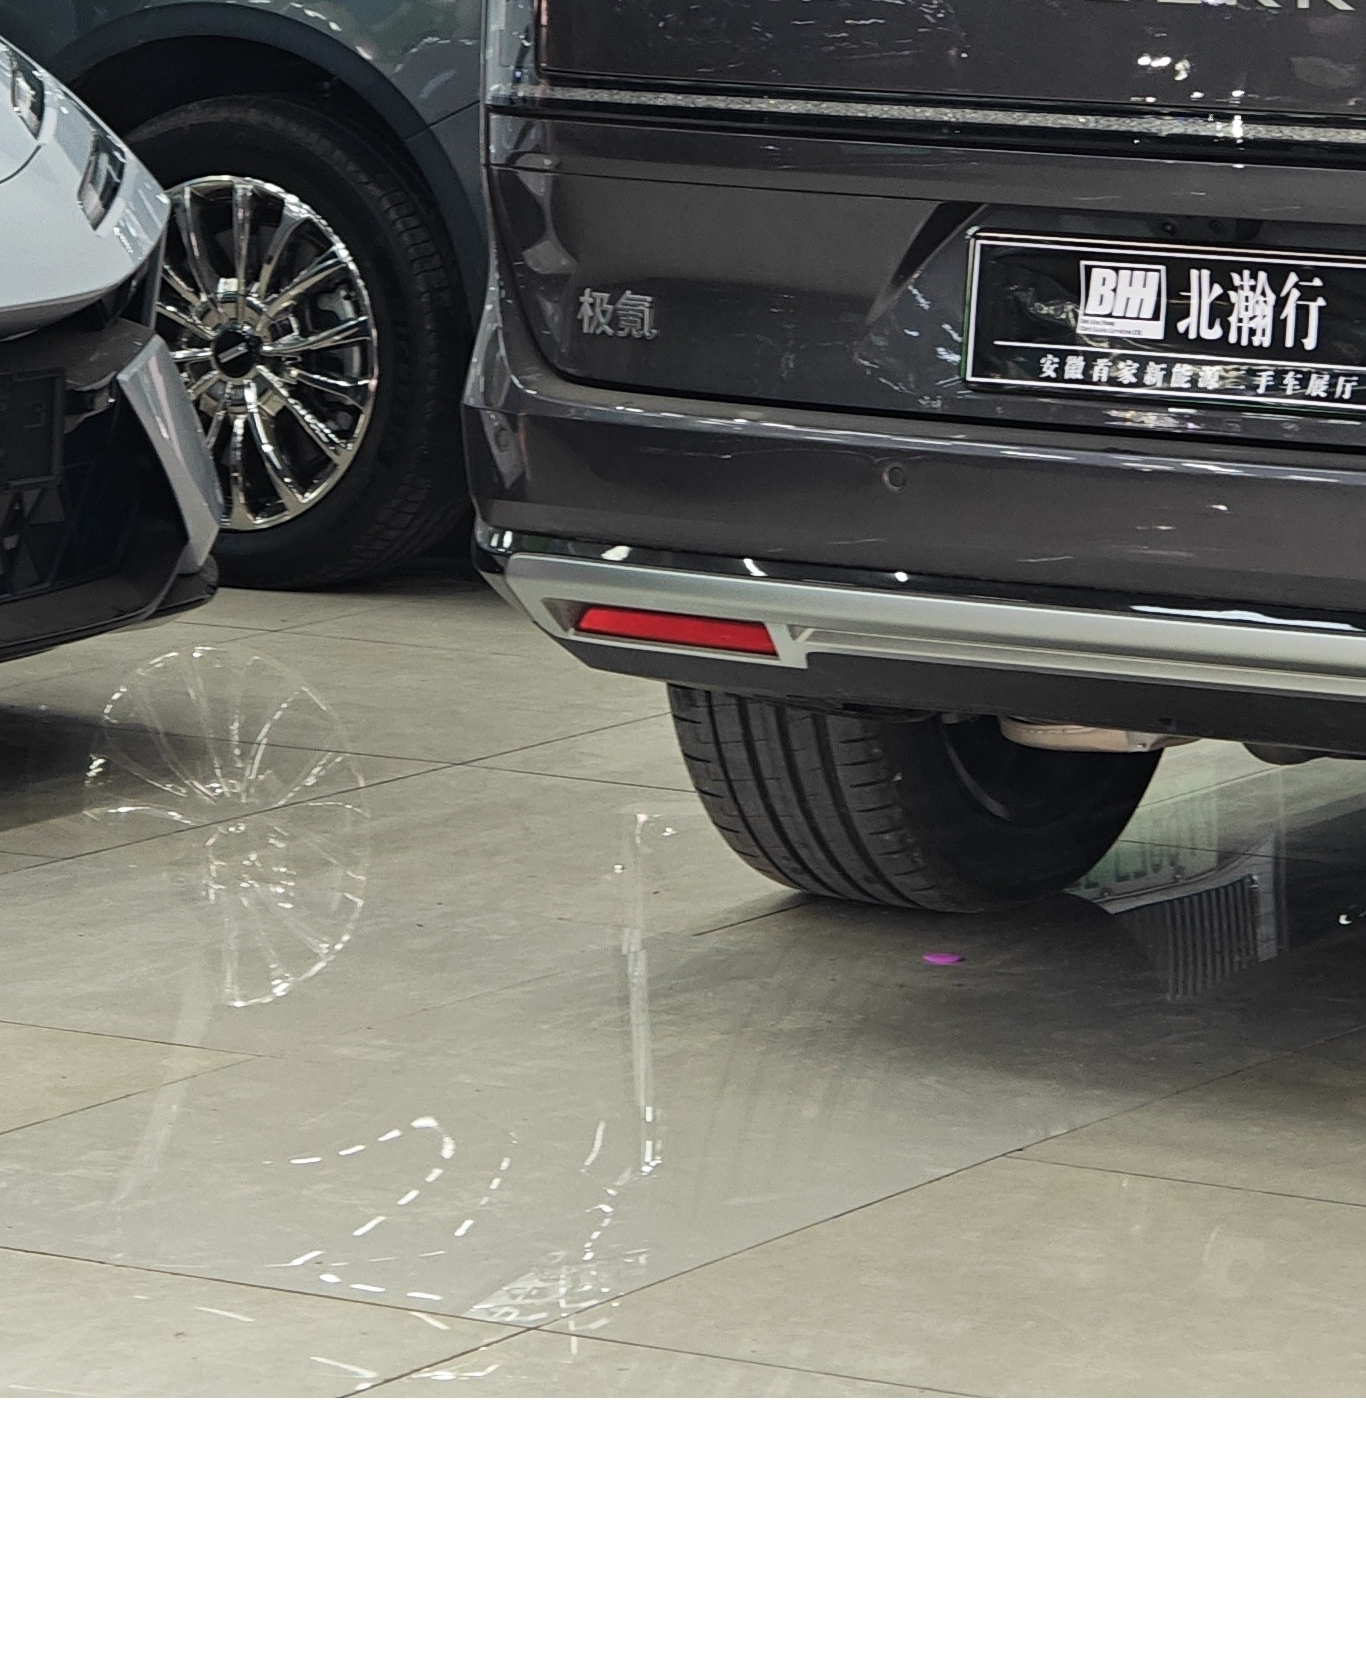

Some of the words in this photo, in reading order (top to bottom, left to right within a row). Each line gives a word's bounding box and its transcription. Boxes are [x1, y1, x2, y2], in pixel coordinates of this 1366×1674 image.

[577, 287, 660, 340] 极氪
[1176, 268, 1327, 351] 北瀚行
[1038, 354, 1360, 400] 安徽首家新能源二手车展厅
